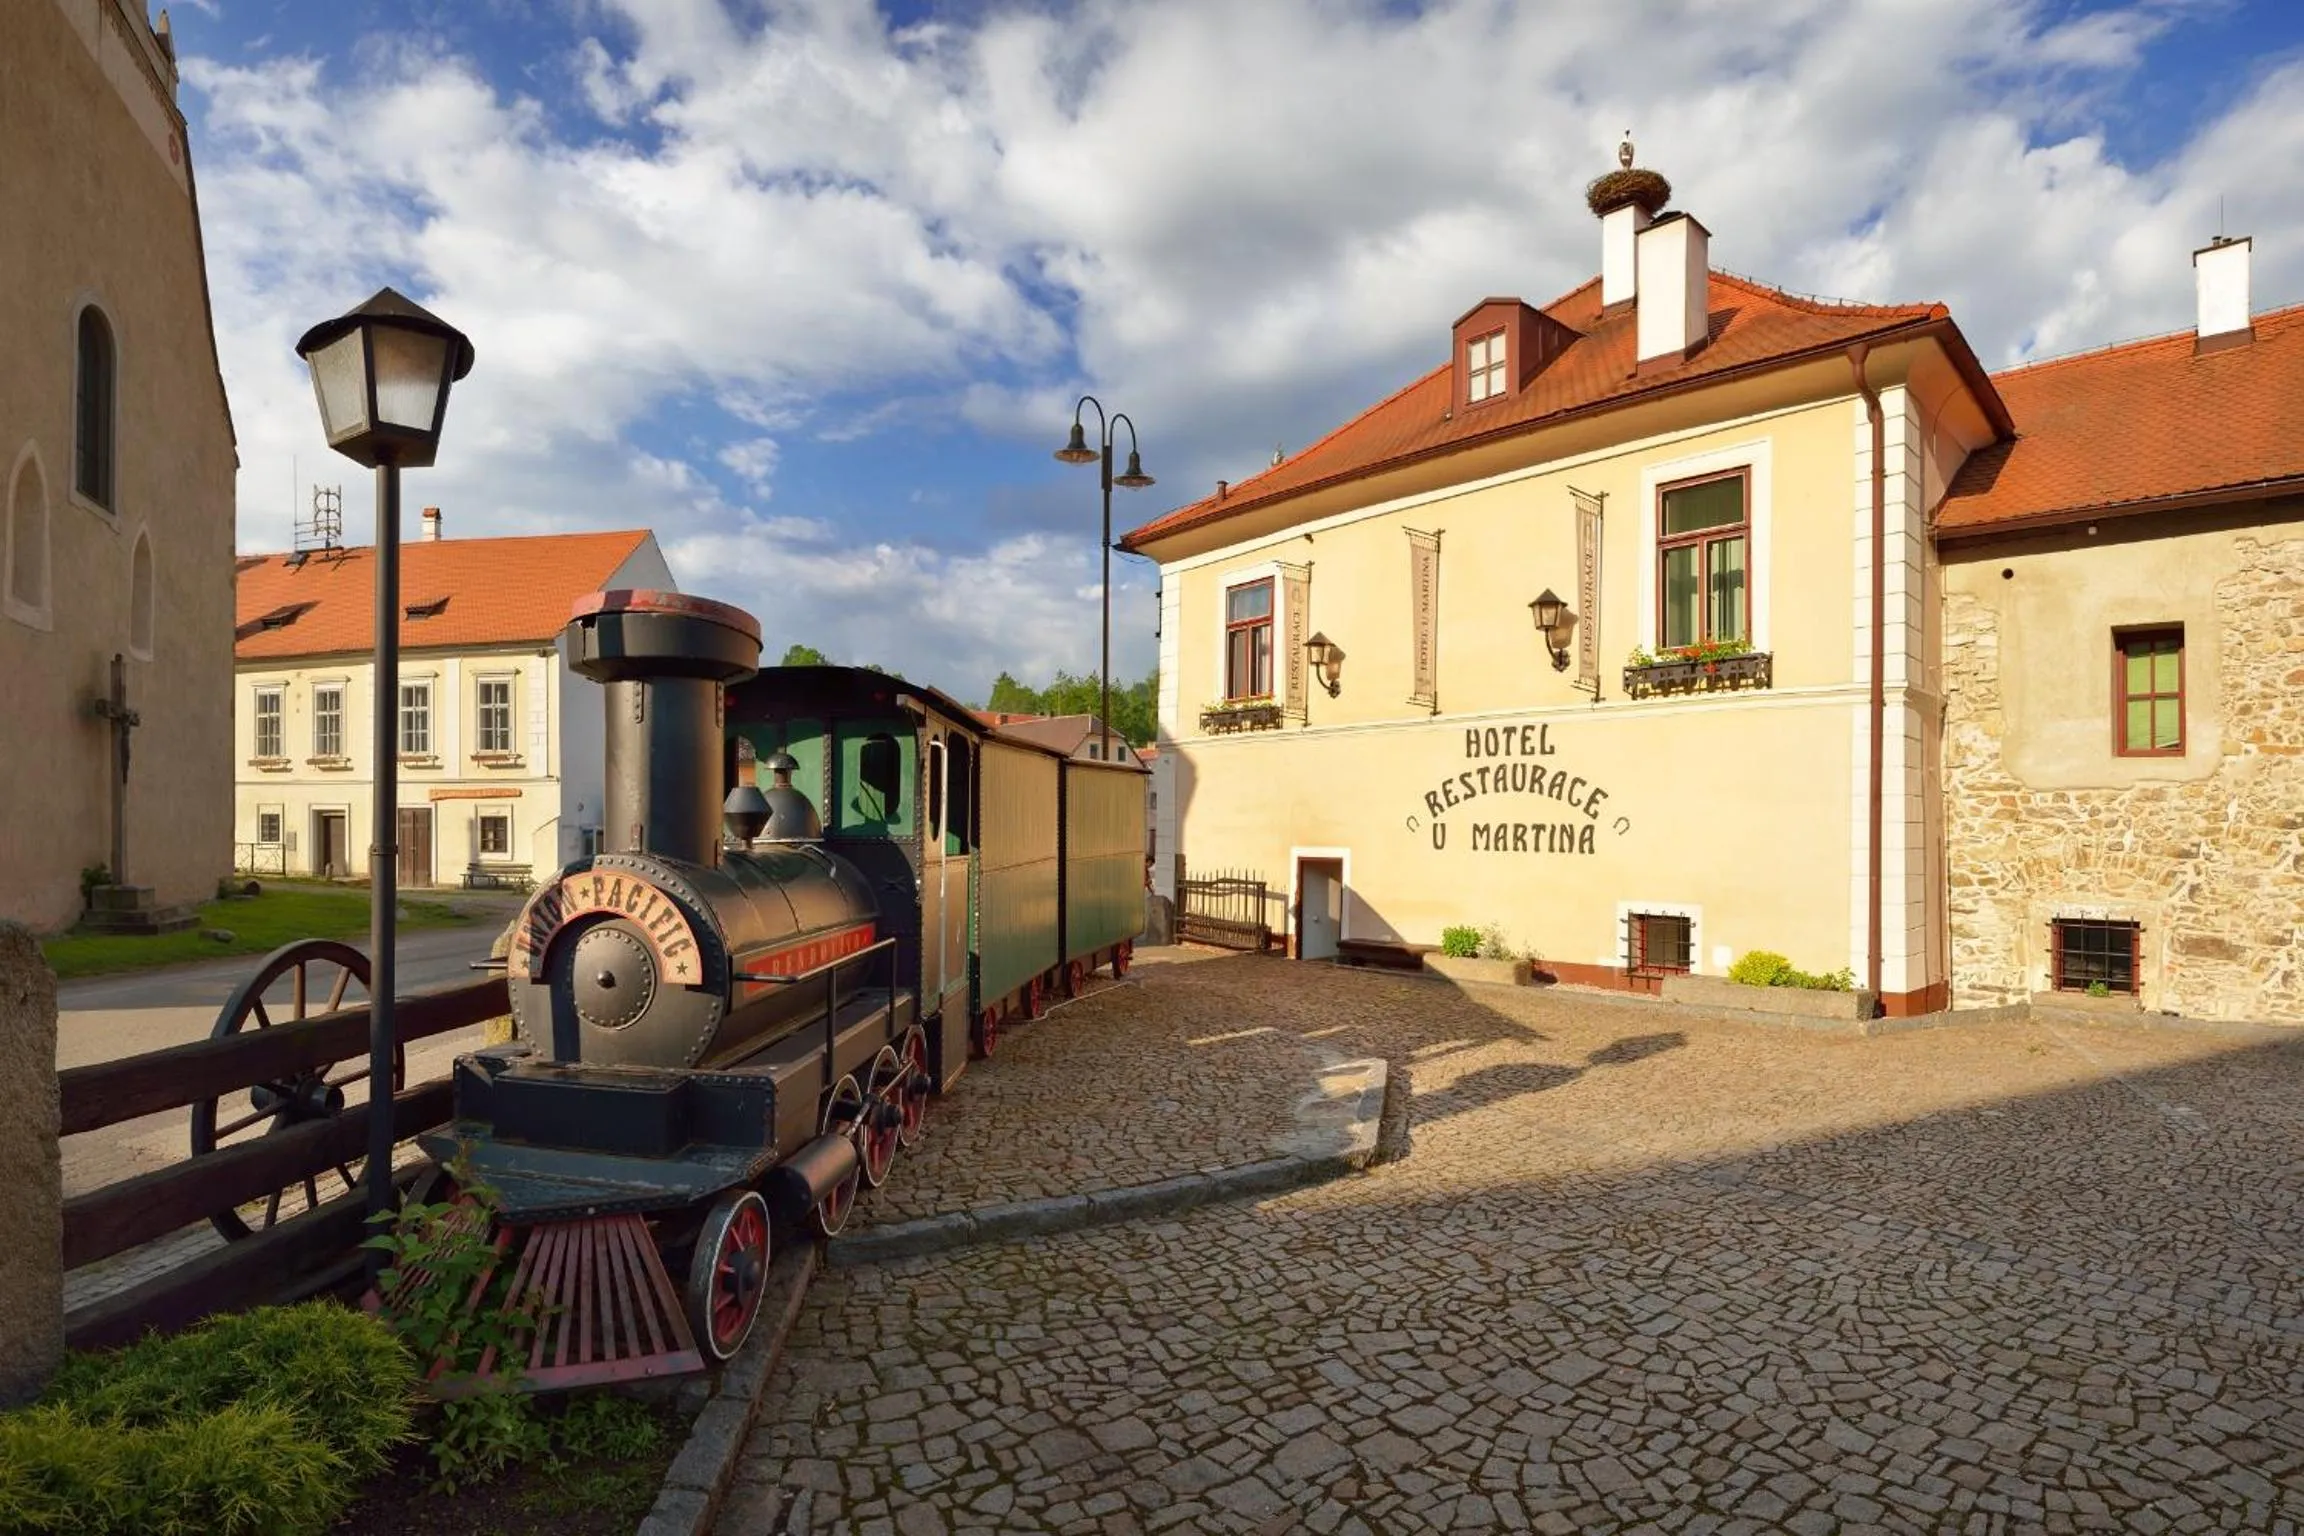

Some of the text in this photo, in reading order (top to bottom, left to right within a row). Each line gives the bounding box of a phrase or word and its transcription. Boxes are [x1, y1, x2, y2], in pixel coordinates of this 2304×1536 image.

[1422, 556, 1431, 613] MARTINA
[1584, 550, 1593, 653] RESTAURACE
[1291, 609, 1302, 690] RESTAURACE
[1465, 723, 1556, 758] HOTEL
[1424, 763, 1609, 820] RESTAURACE
[1432, 823, 1596, 854] U MARTINA
[516, 876, 692, 958] UNION PACIFIC
